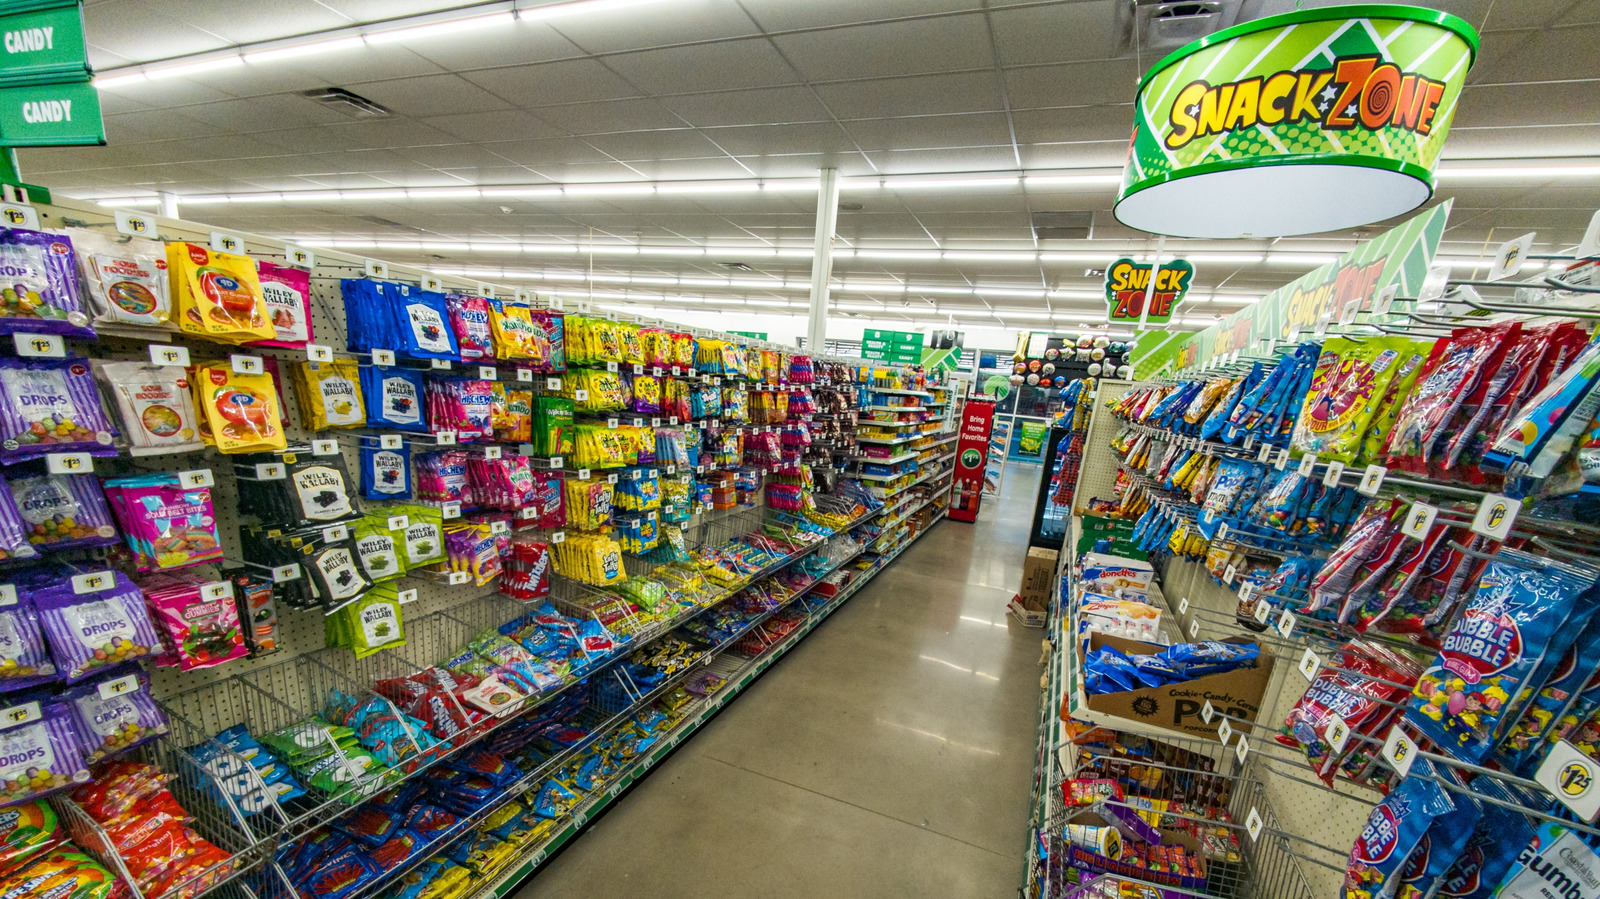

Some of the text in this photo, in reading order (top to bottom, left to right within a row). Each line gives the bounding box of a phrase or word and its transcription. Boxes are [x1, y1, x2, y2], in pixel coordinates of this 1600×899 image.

[4, 26, 53, 53] CANDY
[1167, 53, 1446, 148] SNACK ZONE
[22, 99, 72, 124] CANDY
[1111, 264, 1189, 291] SNACK
[264, 287, 294, 298] WILEY
[412, 312, 441, 323] WALLABY
[874, 331, 881, 339] 8
[906, 334, 913, 342] 9
[325, 382, 348, 390] WILEY
[388, 377, 410, 387] WILEY
[323, 387, 354, 398] WALLABY
[386, 382, 416, 397] WALLABY
[20, 395, 68, 407] DROPS
[969, 416, 985, 425] Bring
[967, 425, 984, 433] Home
[962, 433, 987, 442] Favorites
[376, 454, 395, 462] WILEY
[376, 460, 403, 469] WALLABY
[302, 472, 332, 481] WILEY
[299, 478, 340, 490] WALLABY
[23, 497, 70, 512] DROPS
[168, 508, 186, 517] BELT
[186, 505, 207, 514] BITES
[408, 527, 431, 535] WILEY
[407, 532, 436, 542] WALLABY
[359, 546, 393, 555] WALLABY
[360, 540, 384, 550] WILEY
[323, 554, 348, 565] WILEY
[1100, 568, 1137, 578] donettes
[365, 605, 388, 617] WILEY
[1087, 602, 1119, 611] Zingers
[183, 606, 222, 620] GUMMIES
[364, 610, 392, 624] WALLABY
[82, 619, 127, 637] DROPS
[1443, 635, 1506, 667] BUBBLE
[1169, 689, 1198, 698] Cookie
[1203, 691, 1233, 703] Candy
[94, 704, 132, 725] DROPS
[0, 748, 46, 768] DROPS
[139, 832, 170, 853] original
[1516, 845, 1586, 899] Gumb
